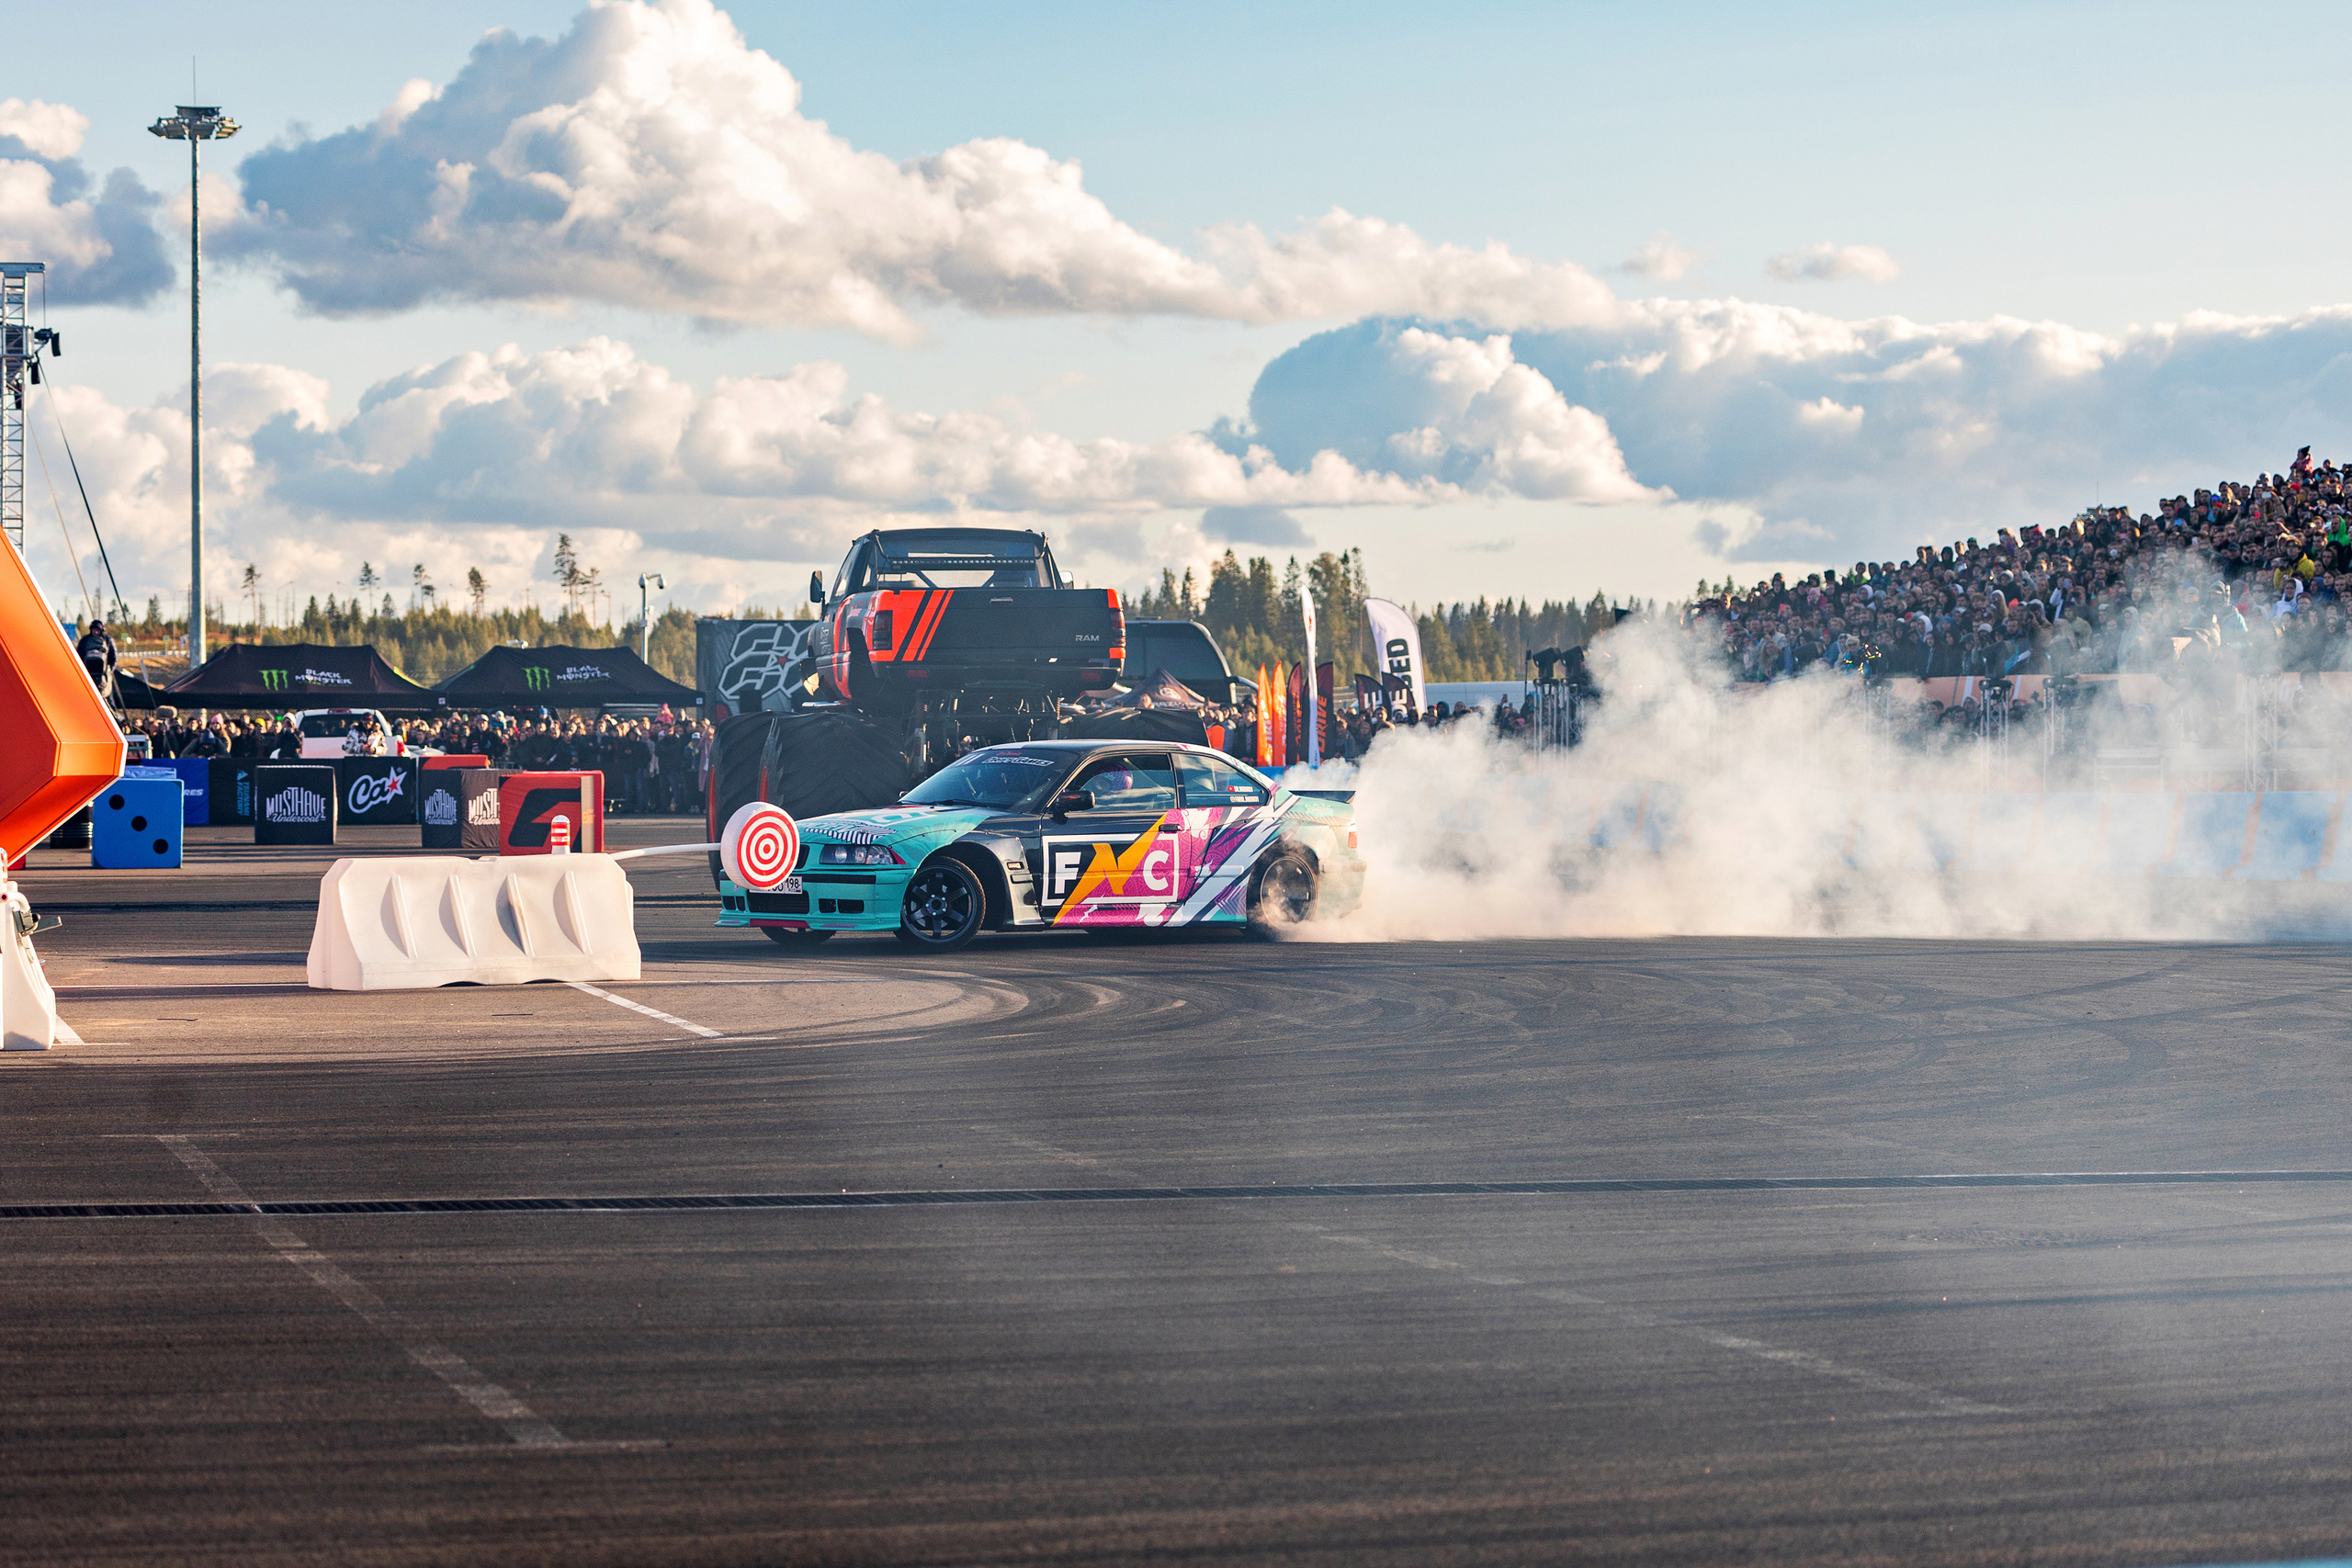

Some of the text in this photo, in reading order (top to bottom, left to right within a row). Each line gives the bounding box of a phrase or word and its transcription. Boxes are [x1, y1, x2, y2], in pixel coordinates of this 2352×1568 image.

[305, 668, 341, 679] BLACK
[295, 674, 352, 685] MONSTER
[1054, 836, 1170, 900] FNC
[785, 878, 799, 888] 198
